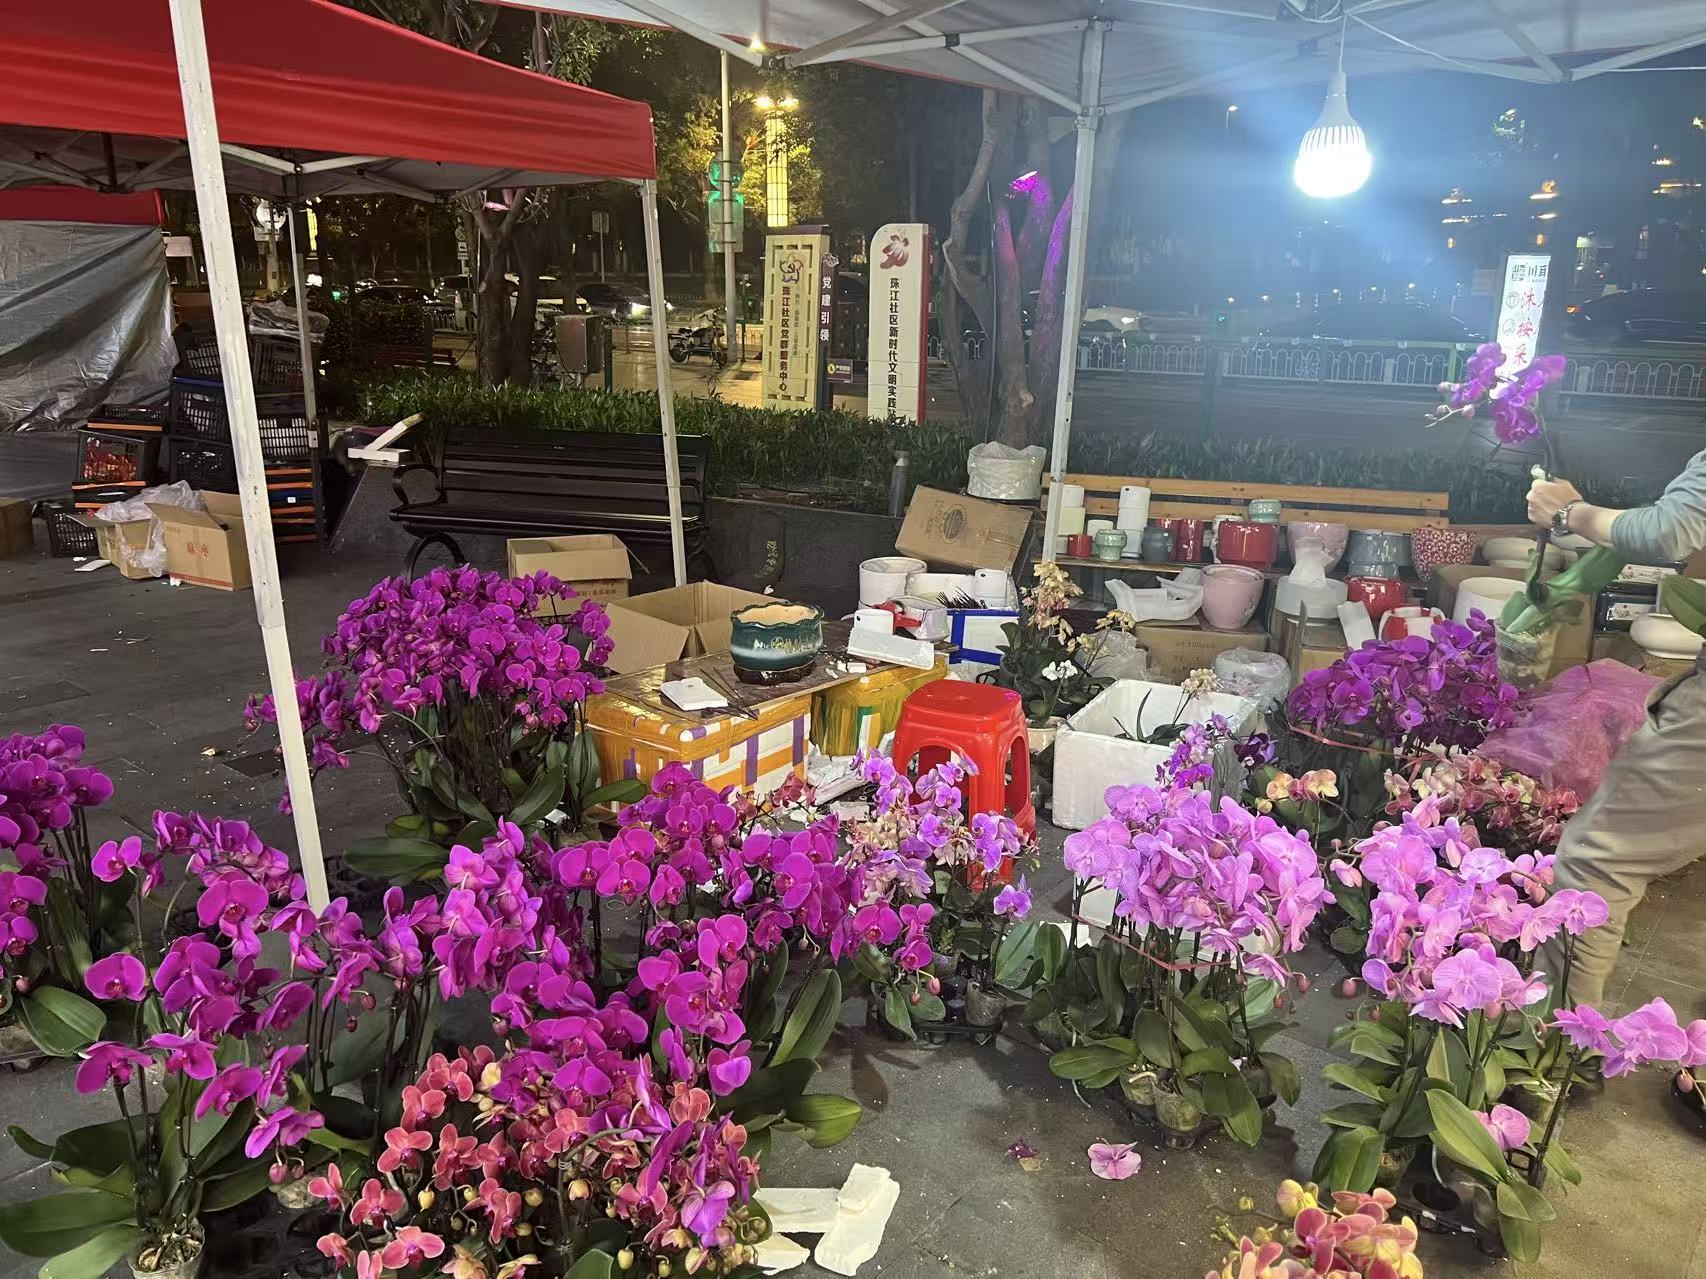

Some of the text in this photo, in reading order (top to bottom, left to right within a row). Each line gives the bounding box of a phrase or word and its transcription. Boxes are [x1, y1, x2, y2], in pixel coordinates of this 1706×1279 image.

[779, 286, 791, 392] 珠江社区党群服务中心
[820, 276, 832, 342] 党建引领
